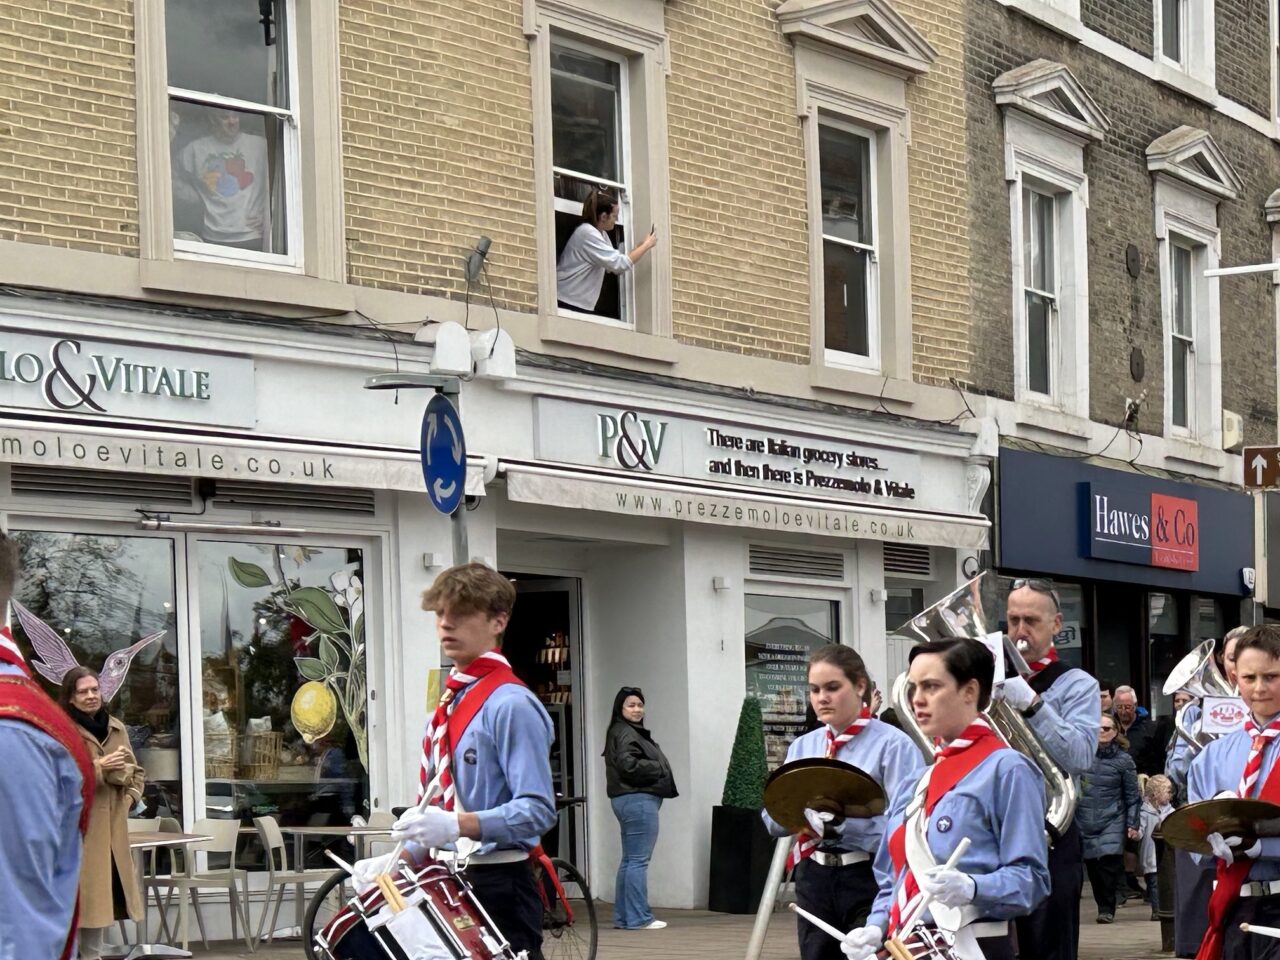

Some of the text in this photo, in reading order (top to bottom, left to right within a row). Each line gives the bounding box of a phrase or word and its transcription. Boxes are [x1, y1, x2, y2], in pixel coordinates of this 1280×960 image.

[597, 411, 668, 470] P&V
[707, 428, 743, 450] There
[745, 437, 765, 453] are
[767, 438, 801, 459] Italian
[803, 445, 844, 469] grocery
[709, 458, 915, 499] and then there is Prezzemolo & Vitale
[616, 491, 915, 539] www.prezzemoloevitale.co.uk
[1095, 495, 1195, 547] Hawes & Co
